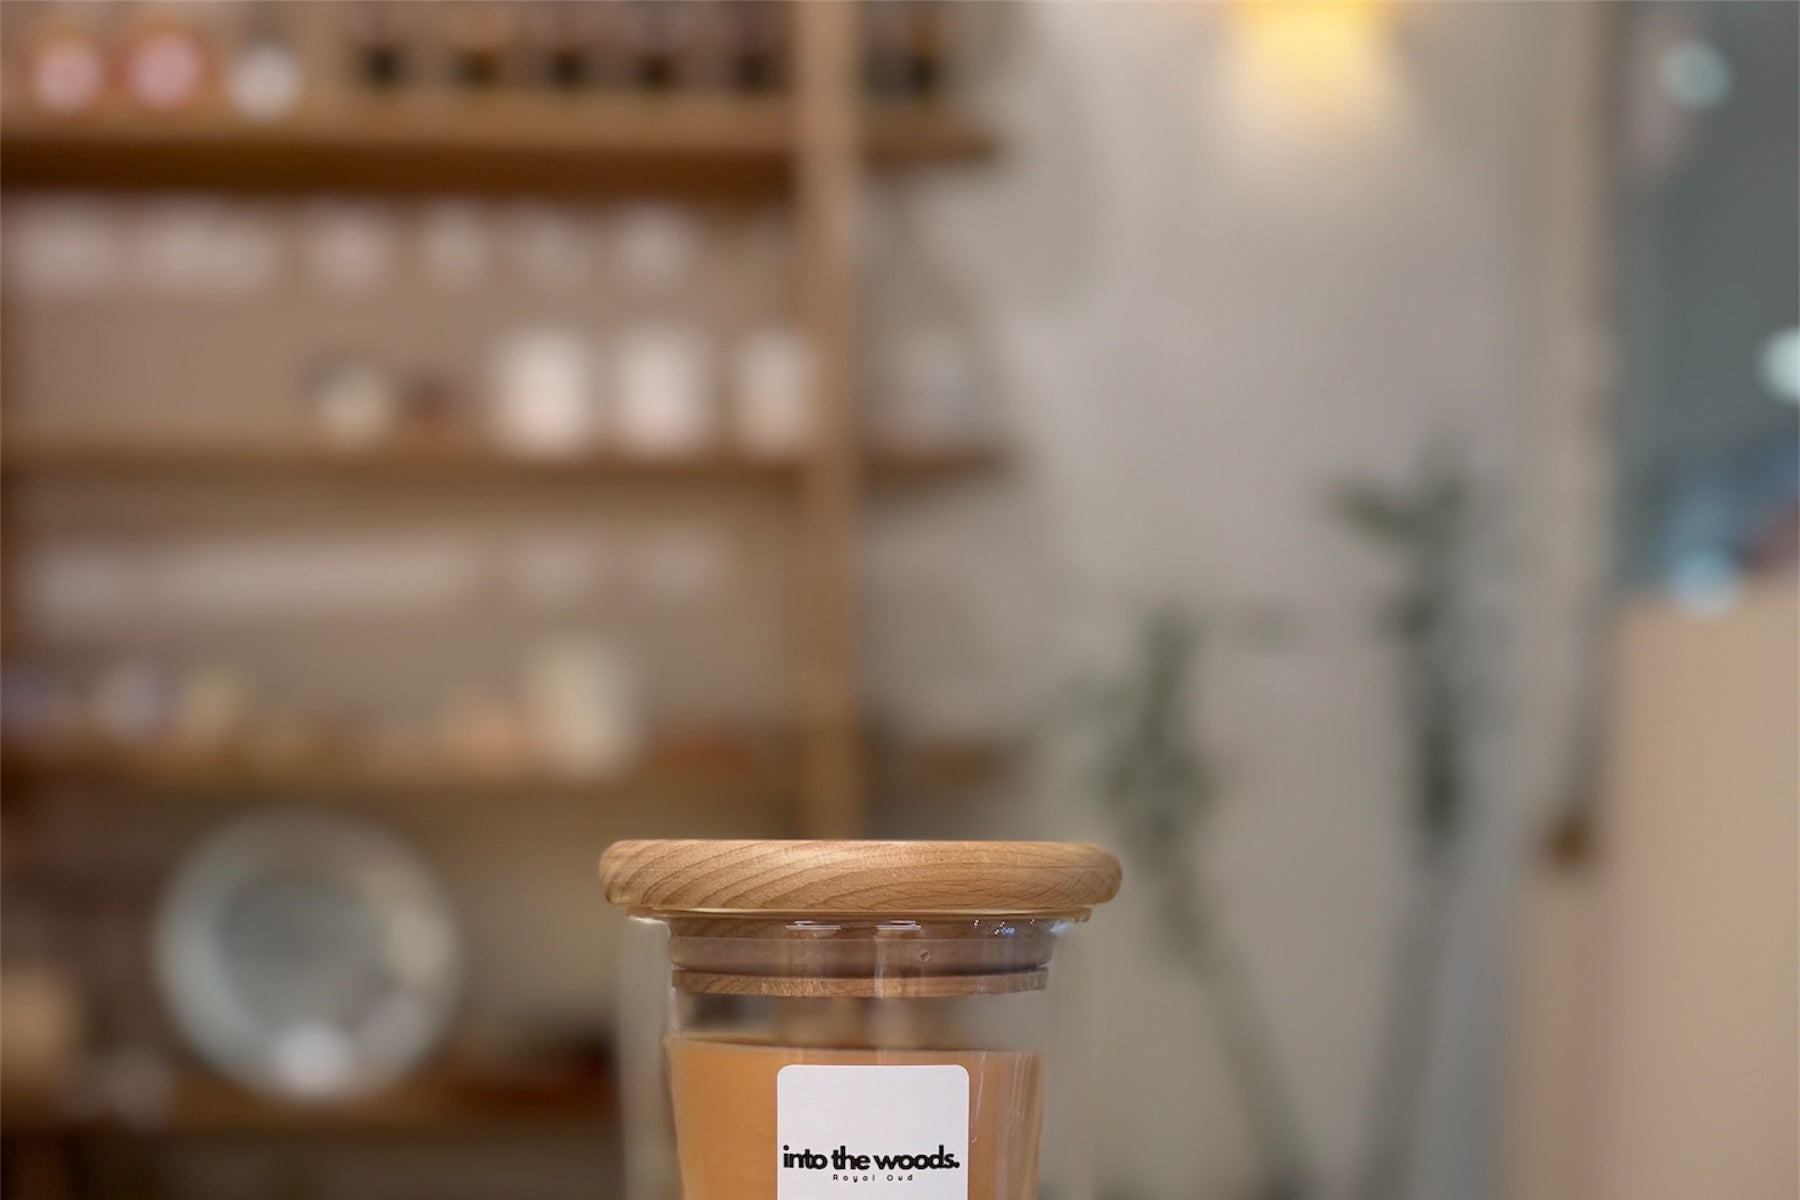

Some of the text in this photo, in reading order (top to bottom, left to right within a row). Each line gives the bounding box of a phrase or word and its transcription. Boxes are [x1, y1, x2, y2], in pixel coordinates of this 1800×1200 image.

[783, 1144, 961, 1170] into the woods.
[832, 1174, 914, 1183] Royal Oud
